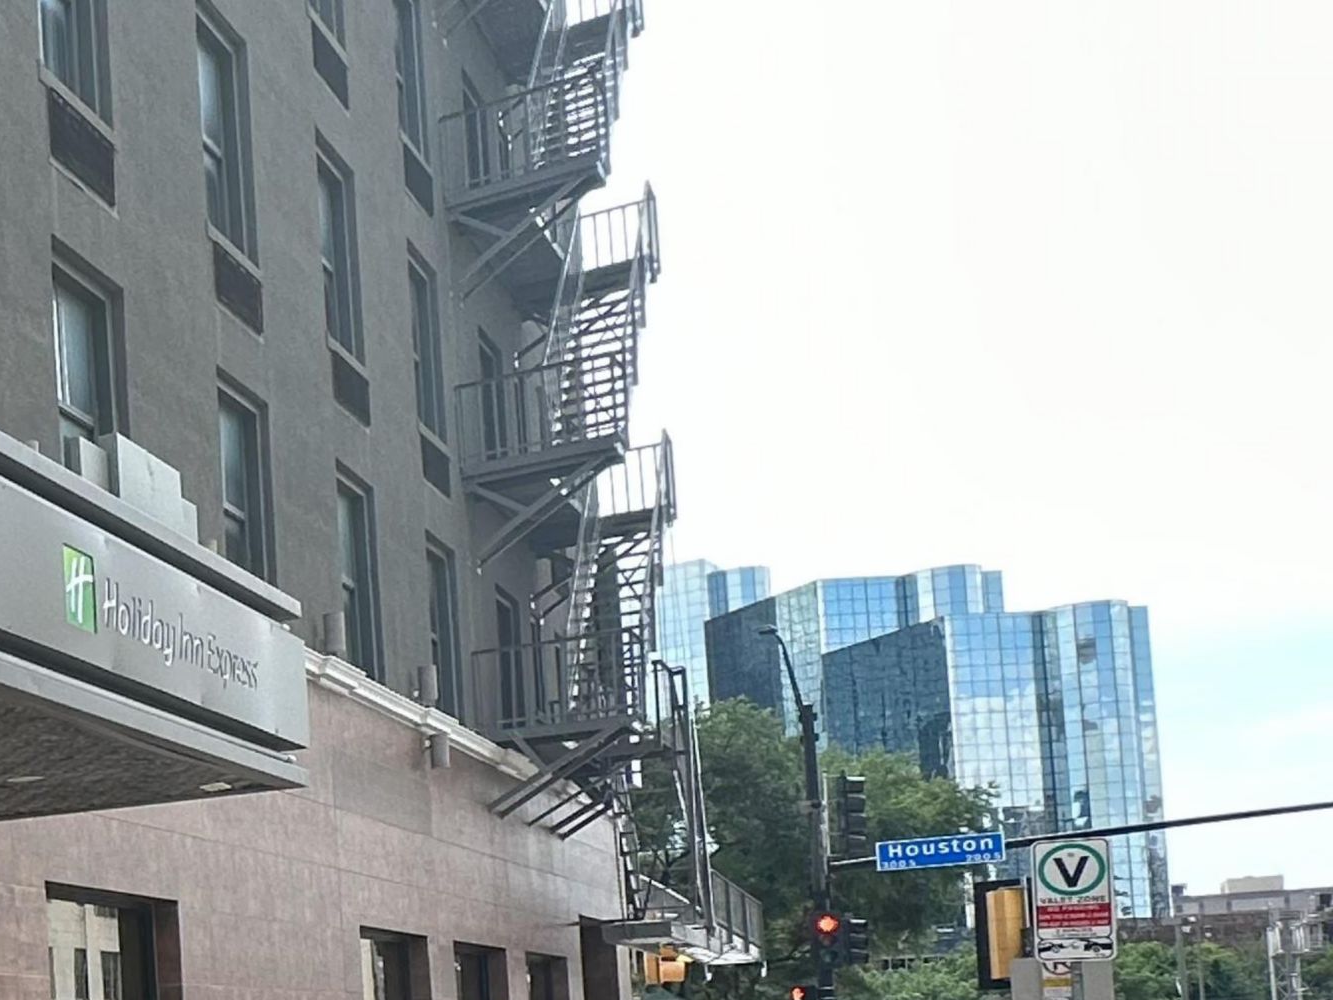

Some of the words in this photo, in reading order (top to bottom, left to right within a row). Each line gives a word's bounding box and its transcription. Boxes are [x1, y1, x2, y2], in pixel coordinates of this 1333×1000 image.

[102, 577, 174, 668] Holiday
[178, 612, 205, 670] Inn
[206, 633, 259, 690] Express
[887, 838, 994, 859] Houston
[1053, 855, 1089, 888] V
[1039, 896, 1073, 904] VALET
[1076, 895, 1107, 903] ZONE
